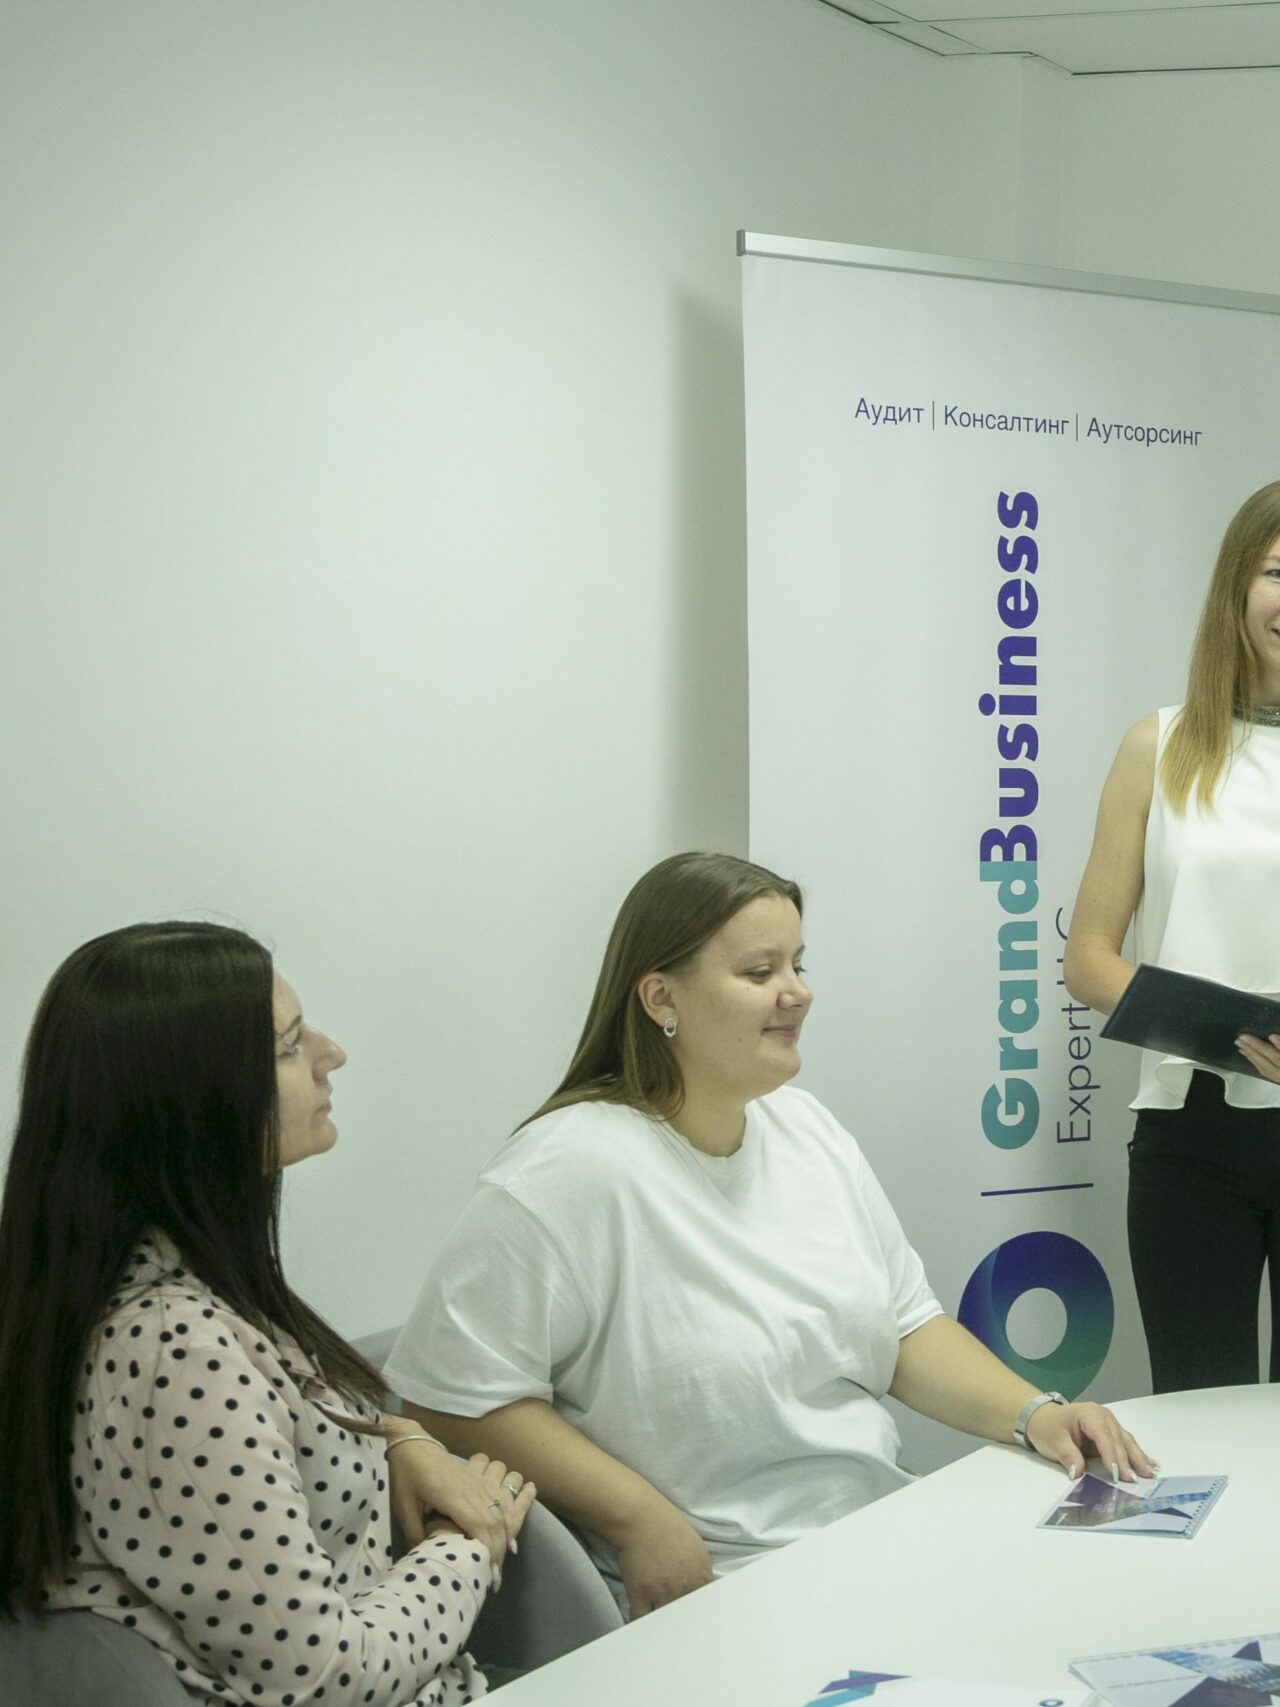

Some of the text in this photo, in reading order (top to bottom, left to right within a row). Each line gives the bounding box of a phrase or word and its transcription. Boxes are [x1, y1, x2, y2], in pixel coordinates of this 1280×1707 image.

[855, 397, 1202, 447] Аудит Консалтинг Аутсорсинг
[979, 490, 1041, 1151] GrandBusiness
[1056, 1002, 1101, 1144] Expert
